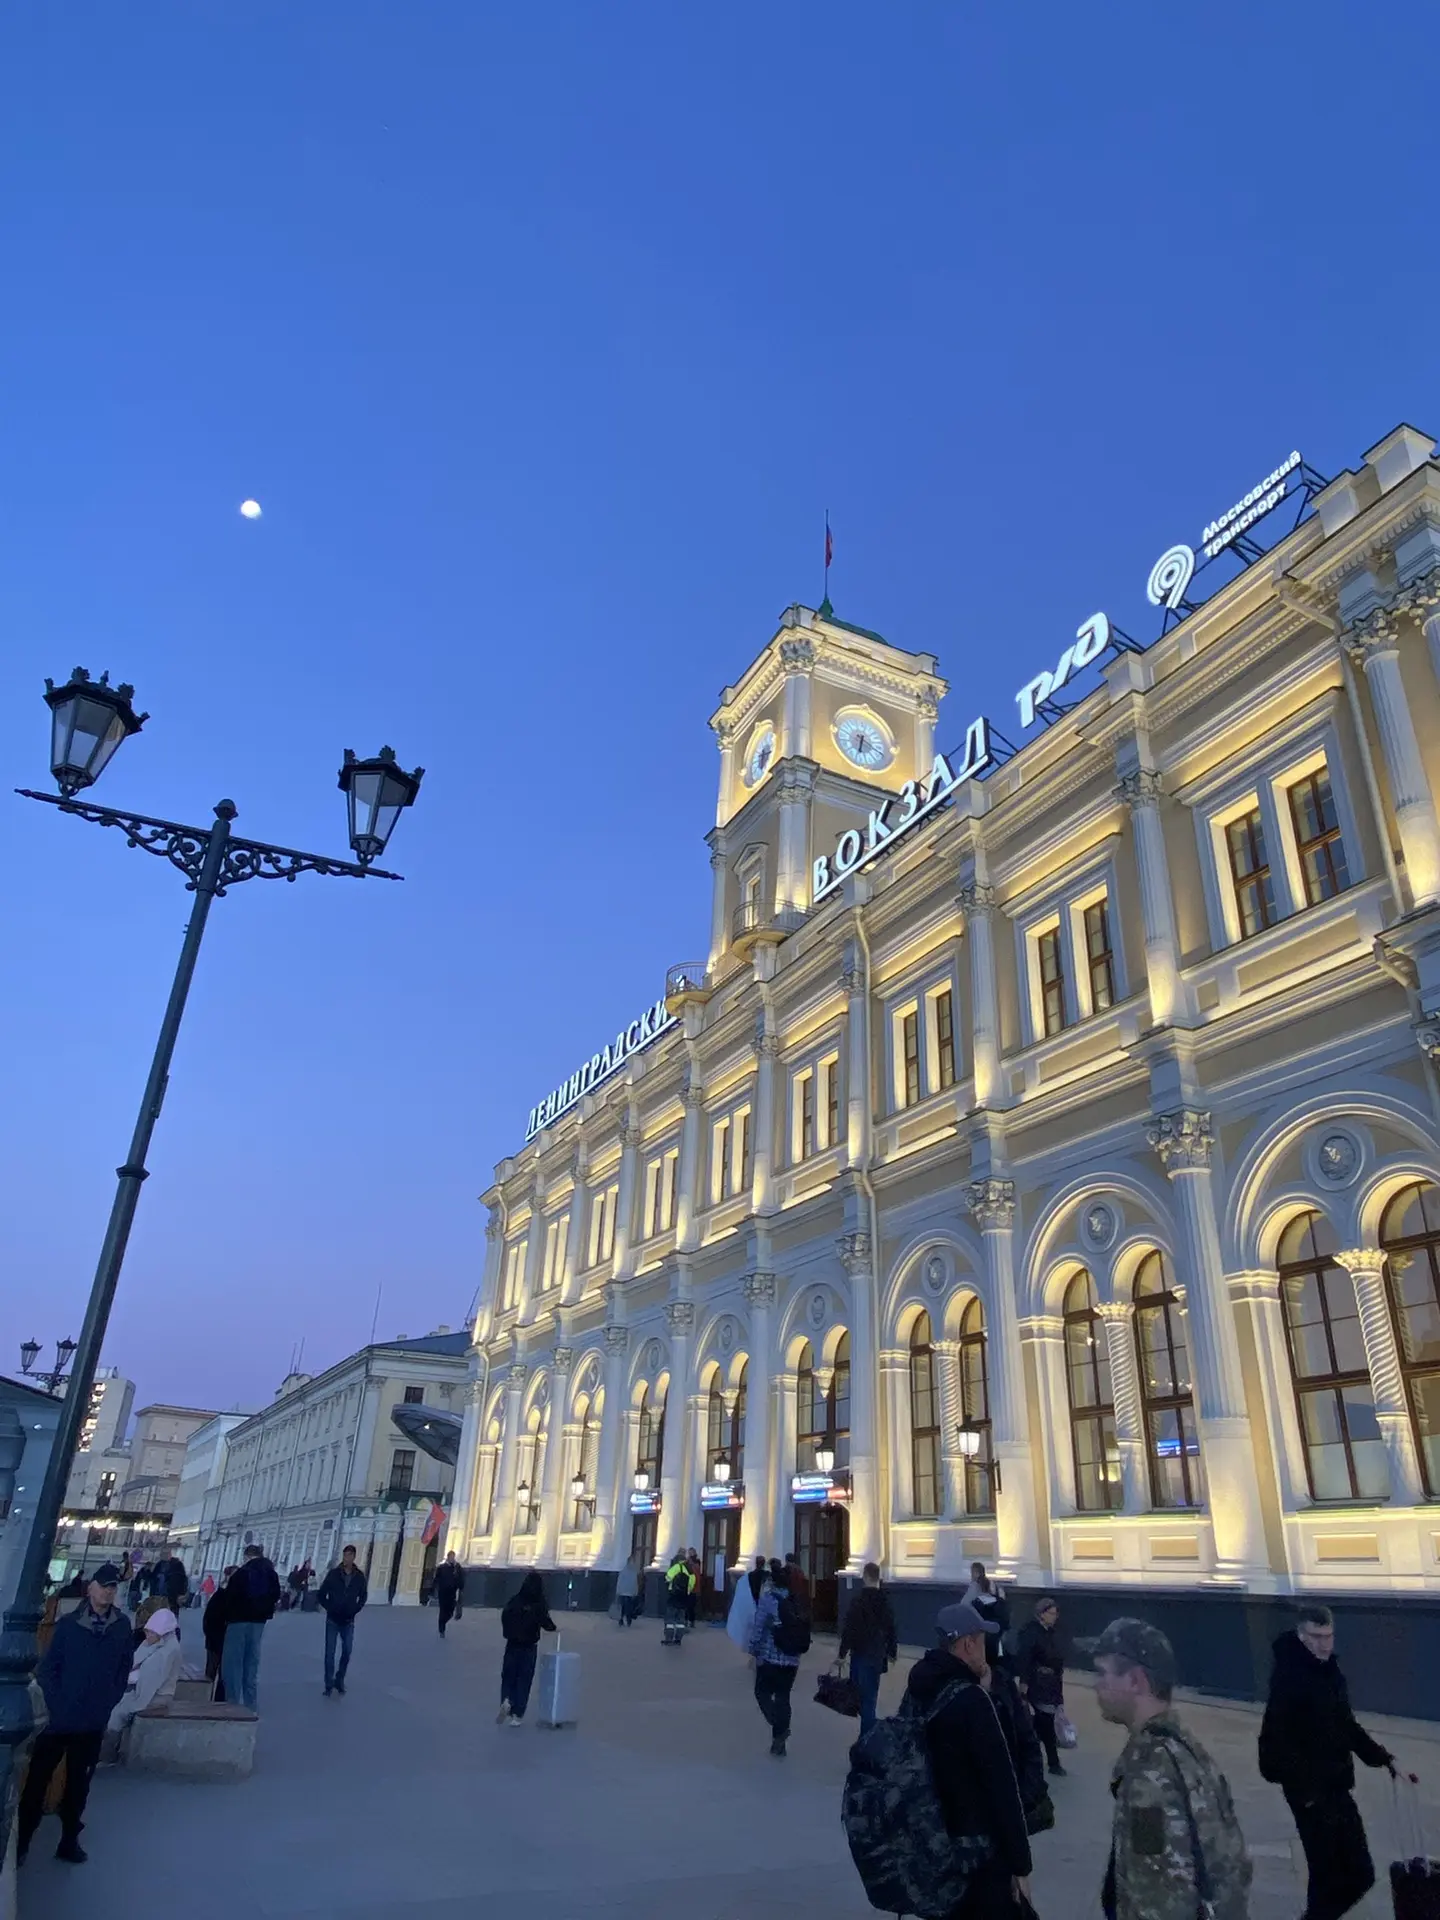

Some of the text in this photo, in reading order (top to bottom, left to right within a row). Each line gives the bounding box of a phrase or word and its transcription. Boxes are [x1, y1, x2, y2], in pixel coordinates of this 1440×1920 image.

[1202, 450, 1301, 543] Московский
[1203, 482, 1287, 558] транспорт
[813, 716, 987, 896] ВОКЗАЛ
